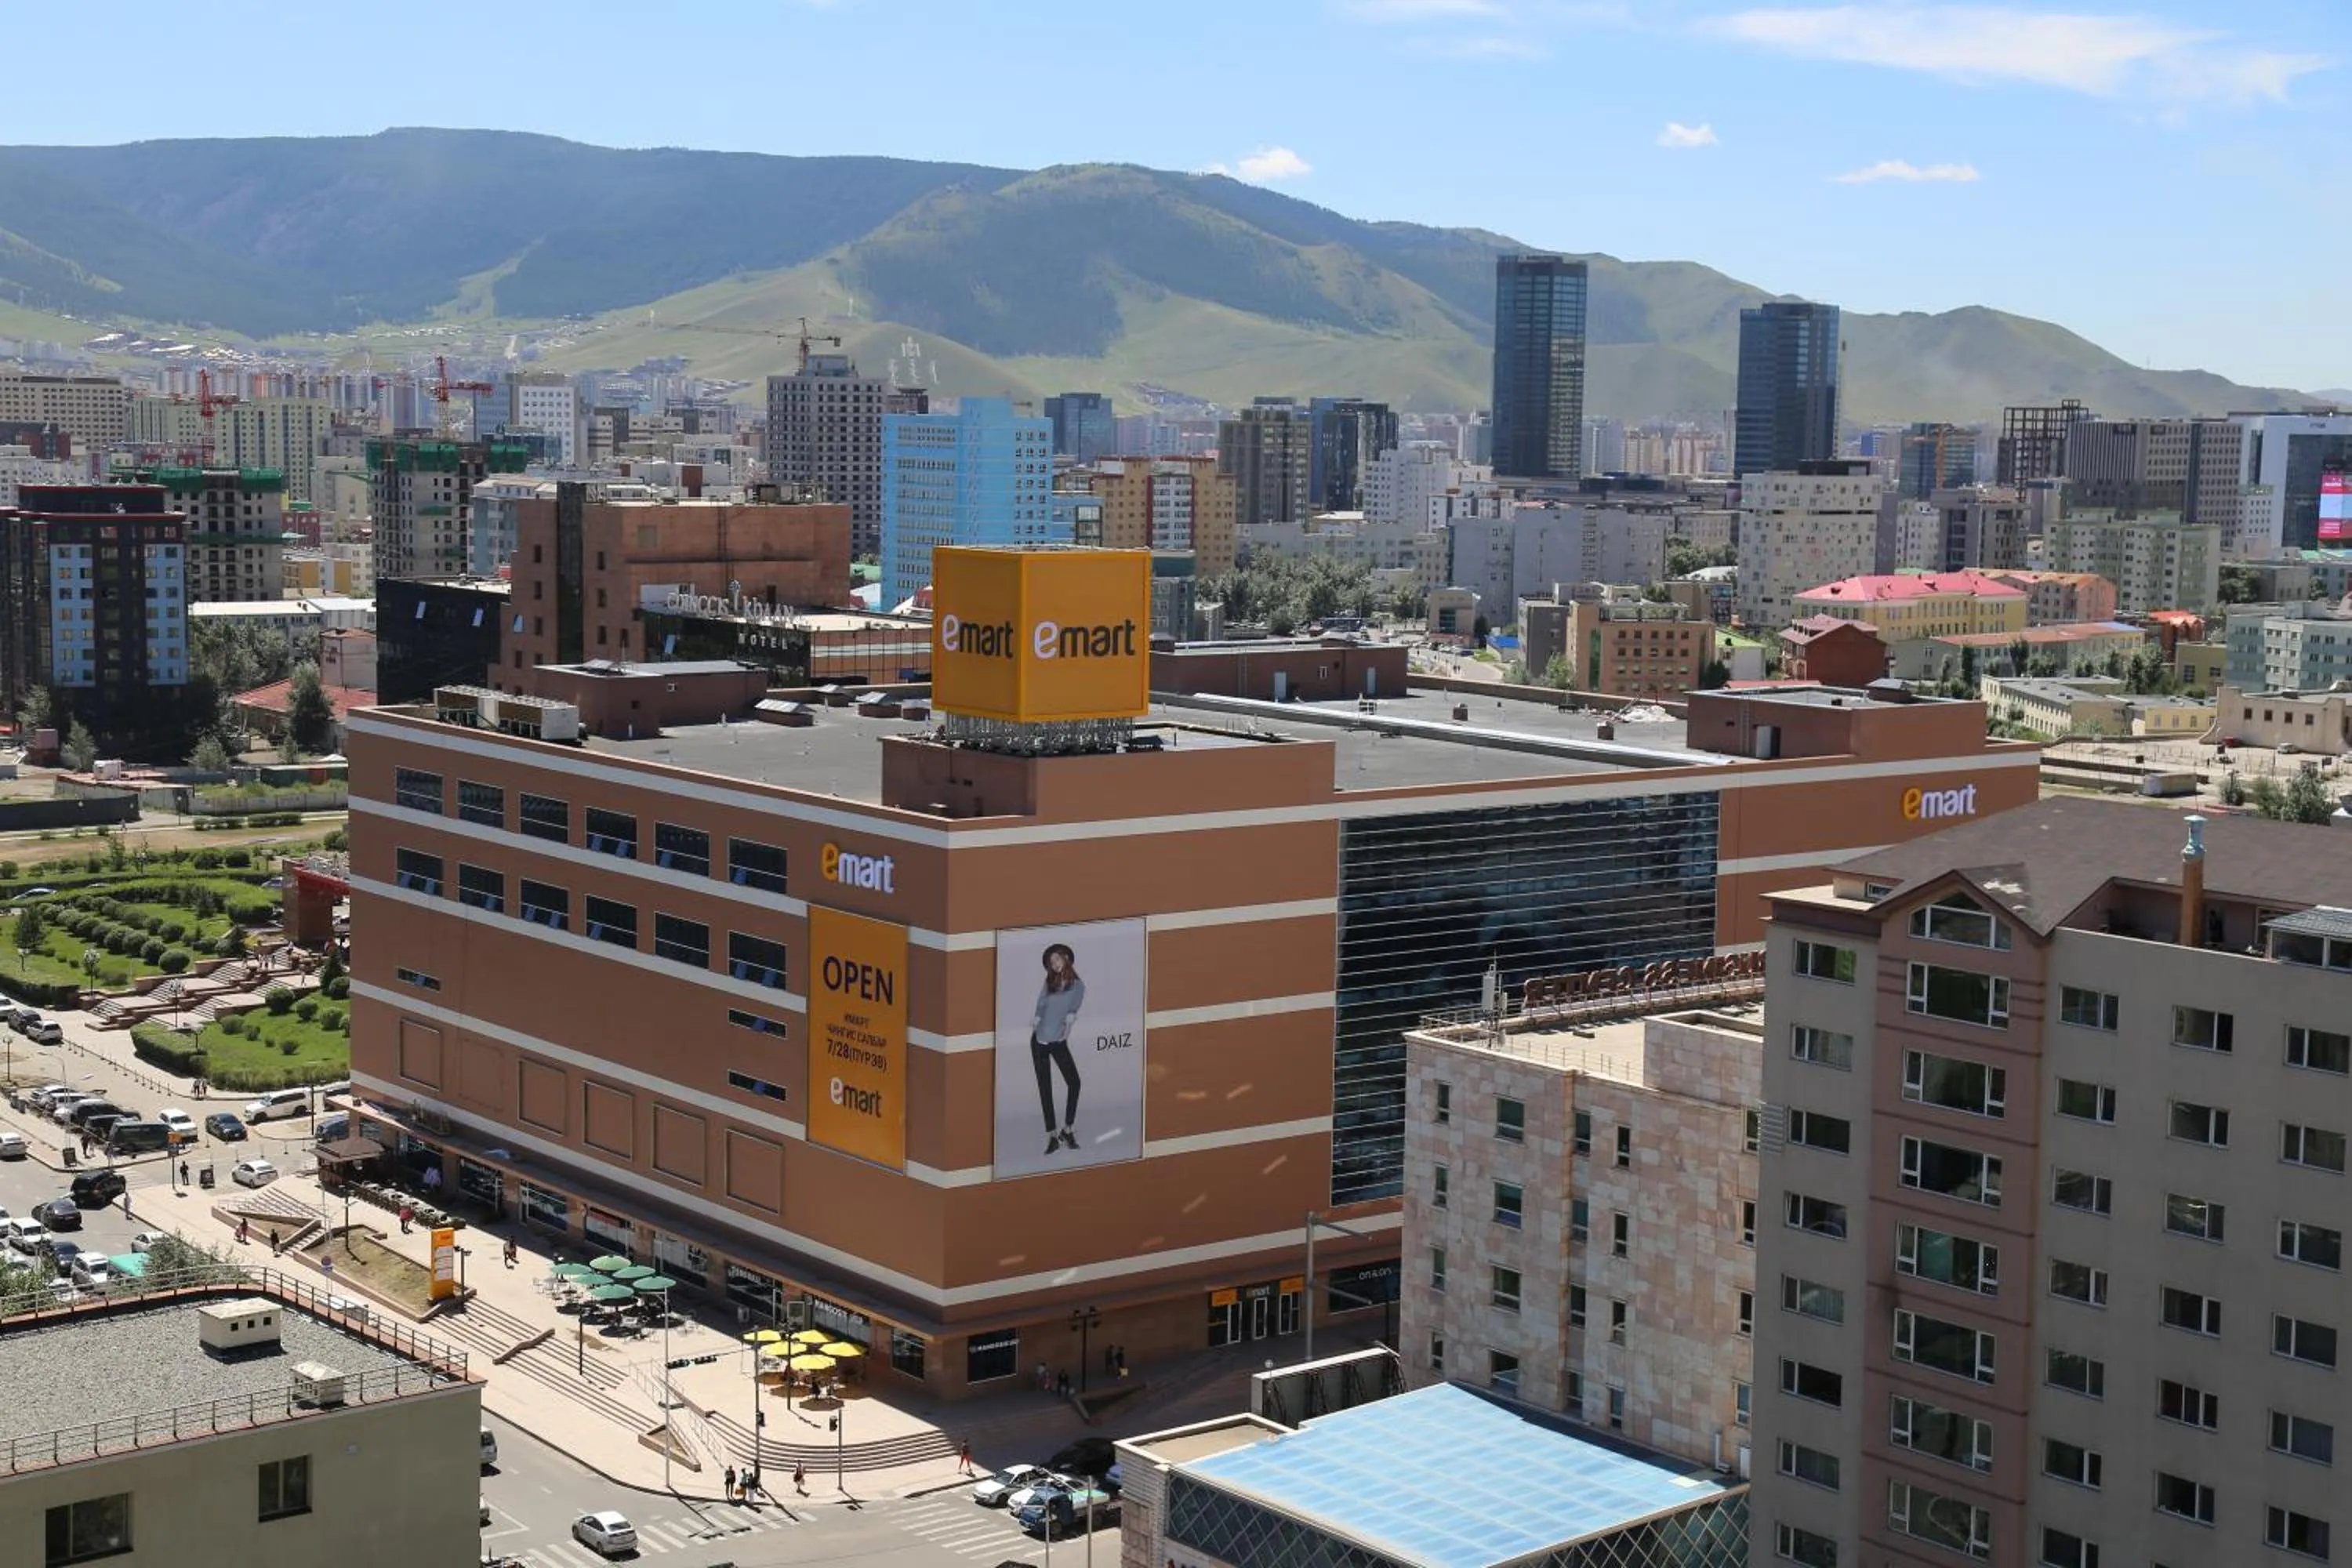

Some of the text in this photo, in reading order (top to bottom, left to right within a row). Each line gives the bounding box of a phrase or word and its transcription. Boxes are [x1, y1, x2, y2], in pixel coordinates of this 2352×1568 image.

[738, 632, 789, 650] HOTEL
[942, 614, 1014, 659] emart
[1033, 619, 1136, 659] emart
[1903, 783, 1976, 819] emart
[821, 842, 895, 894] emart
[822, 956, 893, 1006] OPEN
[1097, 1033, 1133, 1051] DAIZ
[829, 1076, 882, 1118] emart
